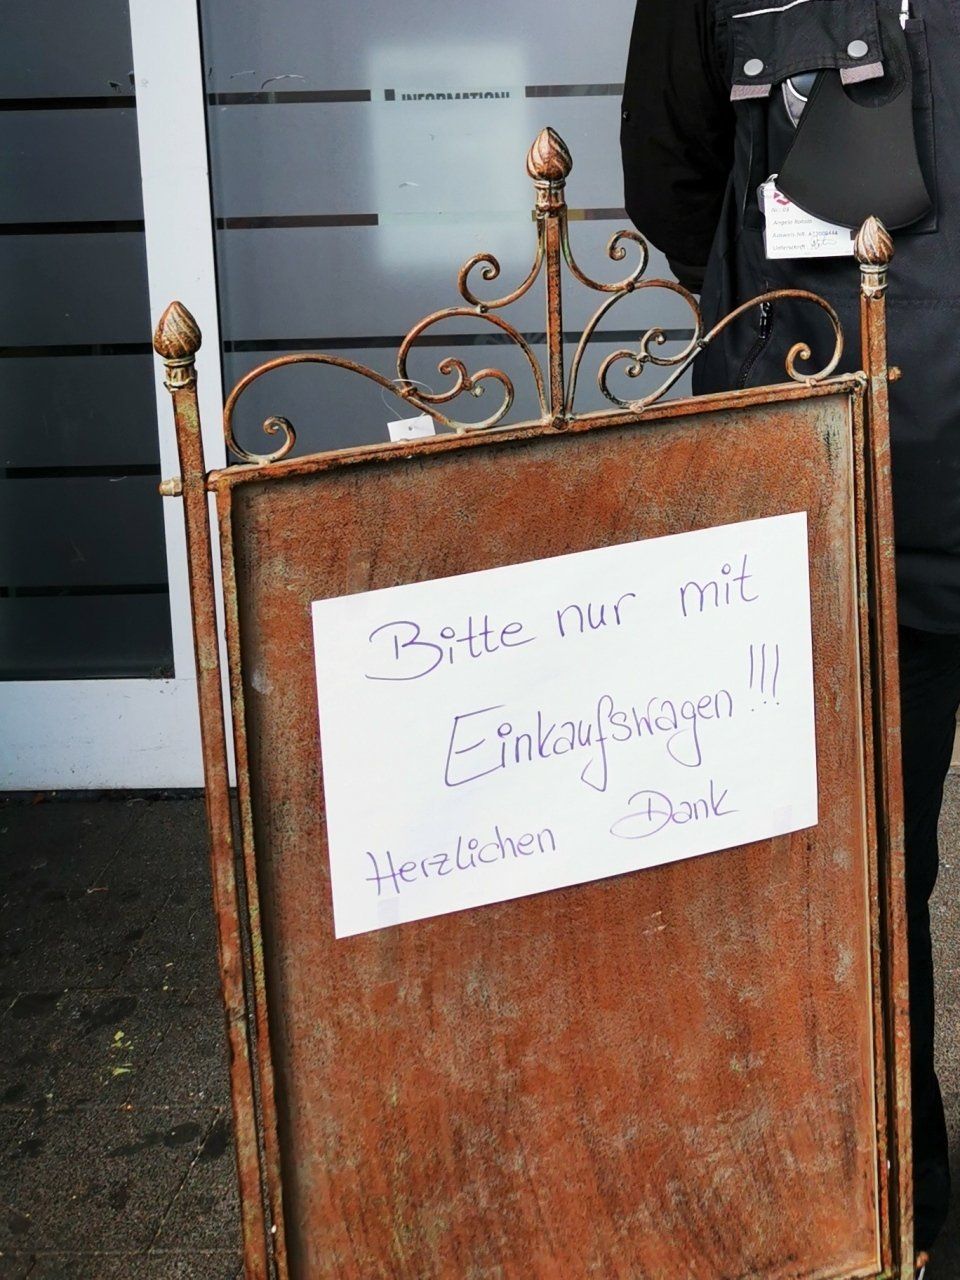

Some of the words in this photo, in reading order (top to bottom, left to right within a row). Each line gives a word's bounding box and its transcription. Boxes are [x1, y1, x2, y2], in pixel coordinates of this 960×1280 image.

[365, 615, 536, 681] Bitte
[557, 593, 636, 638] nur
[681, 554, 759, 616] mit
[366, 825, 557, 896] Herzlichen
[610, 780, 740, 840] Dank
